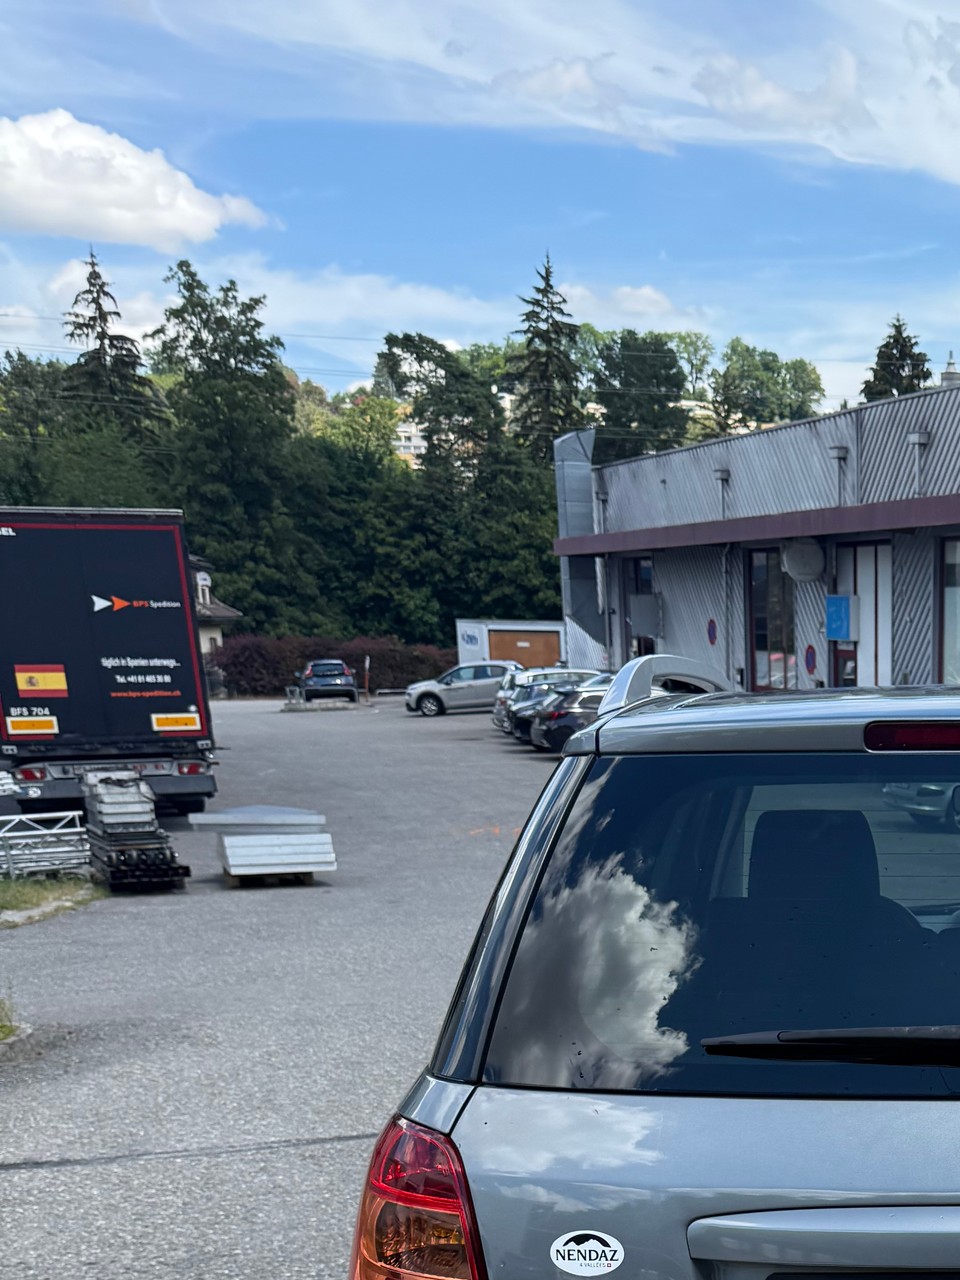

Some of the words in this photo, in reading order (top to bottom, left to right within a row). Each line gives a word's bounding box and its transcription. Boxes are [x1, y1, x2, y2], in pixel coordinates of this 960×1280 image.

[149, 599, 181, 609] Spedition
[30, 706, 51, 716] 704
[555, 1248, 619, 1262] NENDAZ
